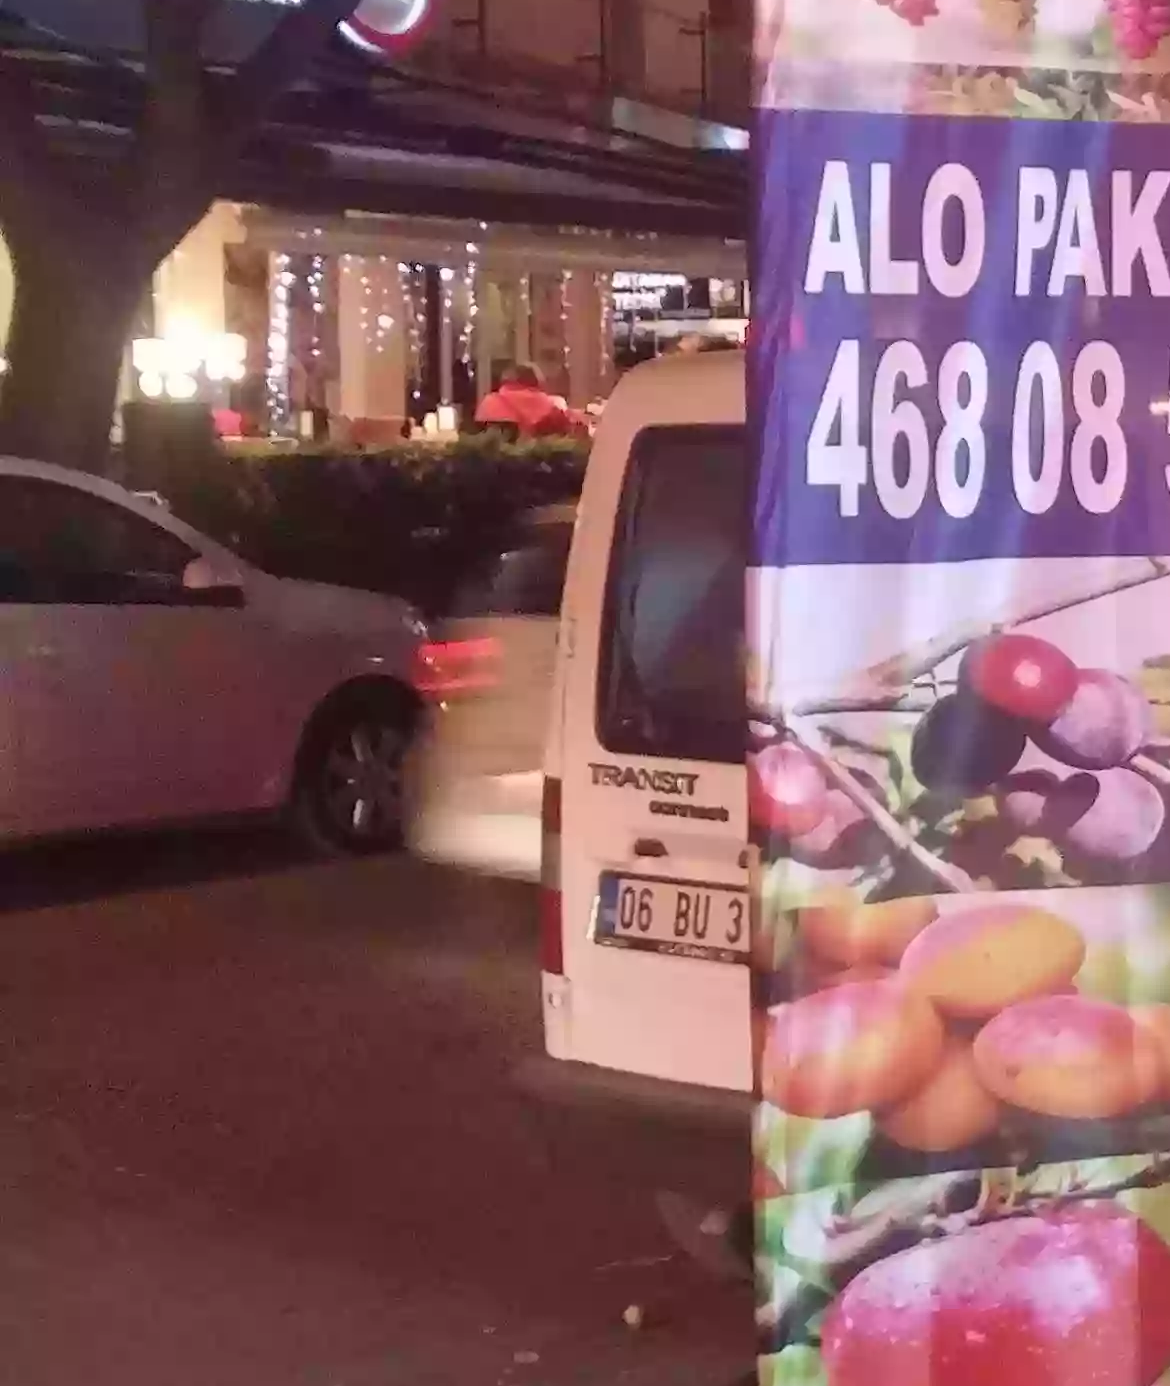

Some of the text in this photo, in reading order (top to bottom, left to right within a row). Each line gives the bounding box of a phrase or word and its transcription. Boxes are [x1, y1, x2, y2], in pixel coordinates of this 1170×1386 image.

[803, 160, 985, 297] ALO
[806, 339, 988, 519] 468
[1012, 340, 1128, 515] 08
[588, 763, 699, 796] TRANSIT
[620, 886, 744, 945] 06 BU 3
